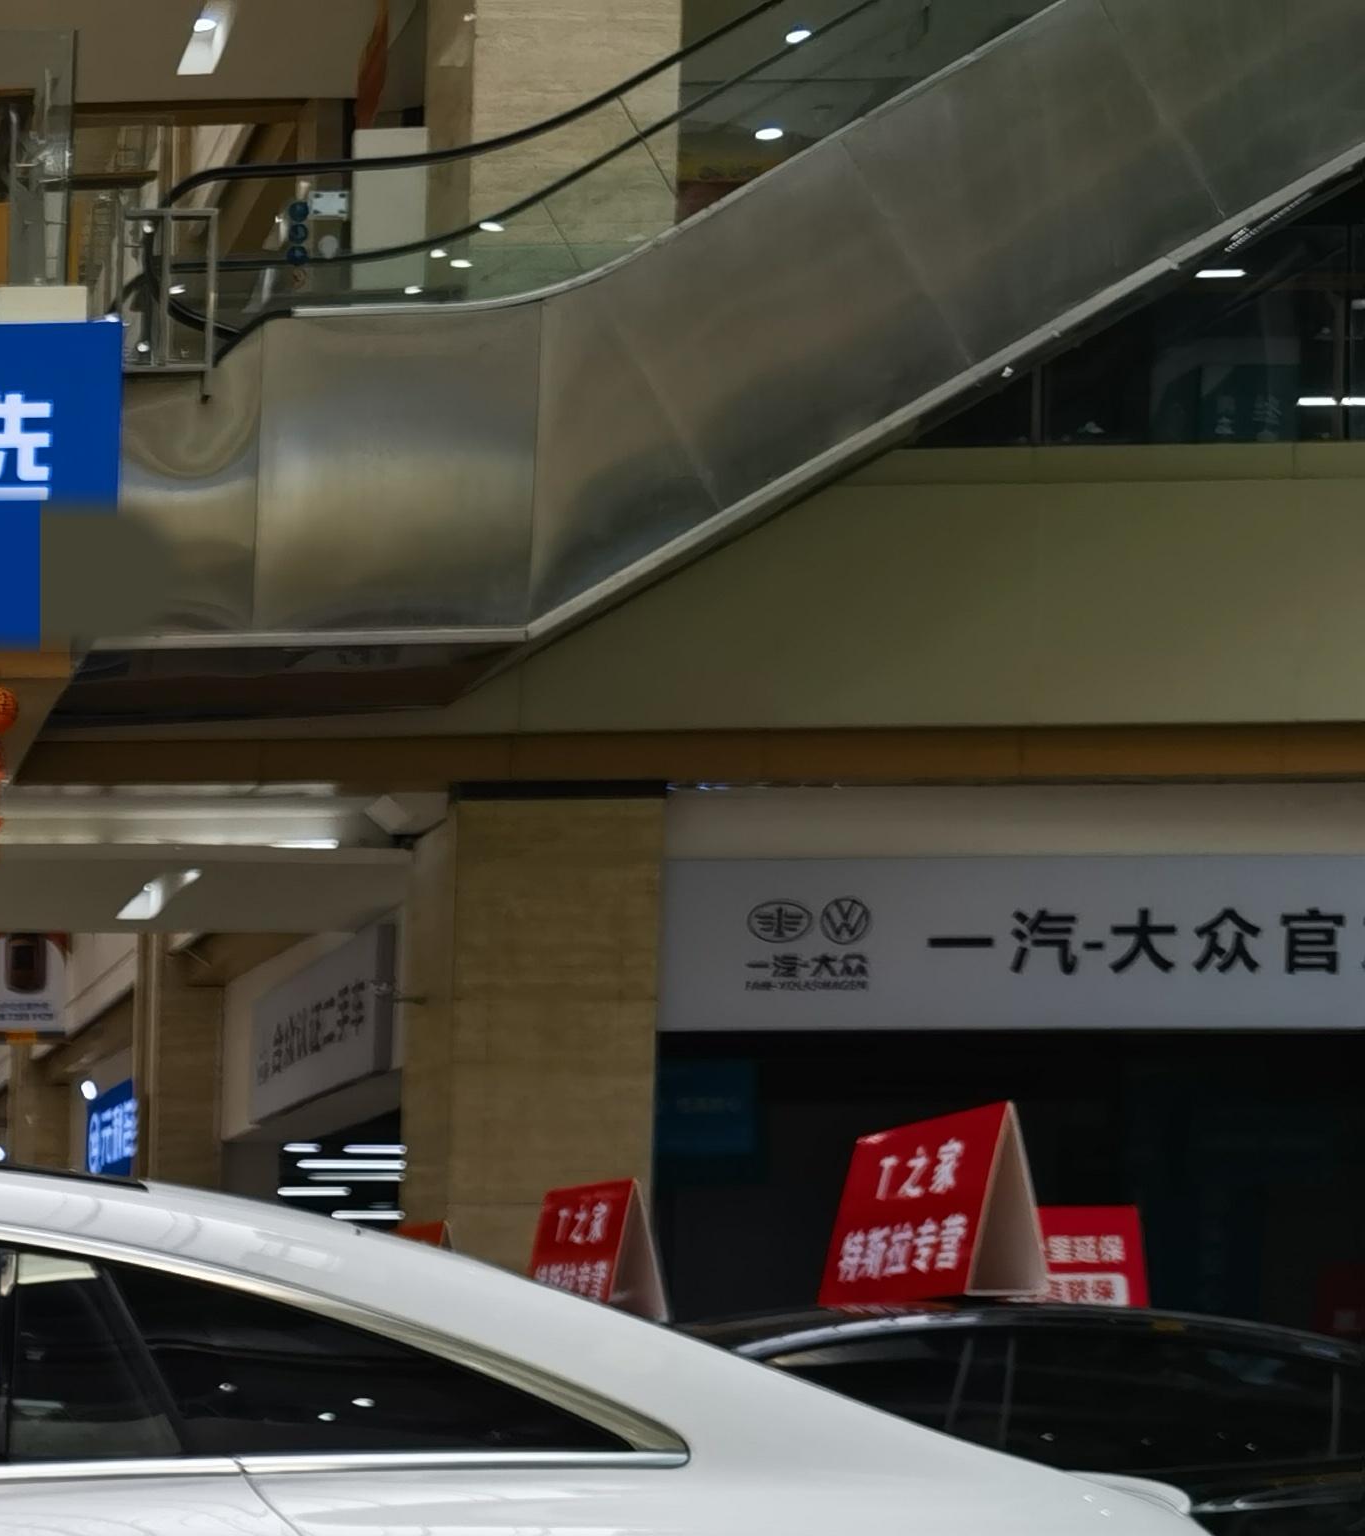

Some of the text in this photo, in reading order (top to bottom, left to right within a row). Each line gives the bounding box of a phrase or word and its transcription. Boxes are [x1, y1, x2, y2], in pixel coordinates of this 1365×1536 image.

[927, 907, 1365, 976] 一汽-大众官
